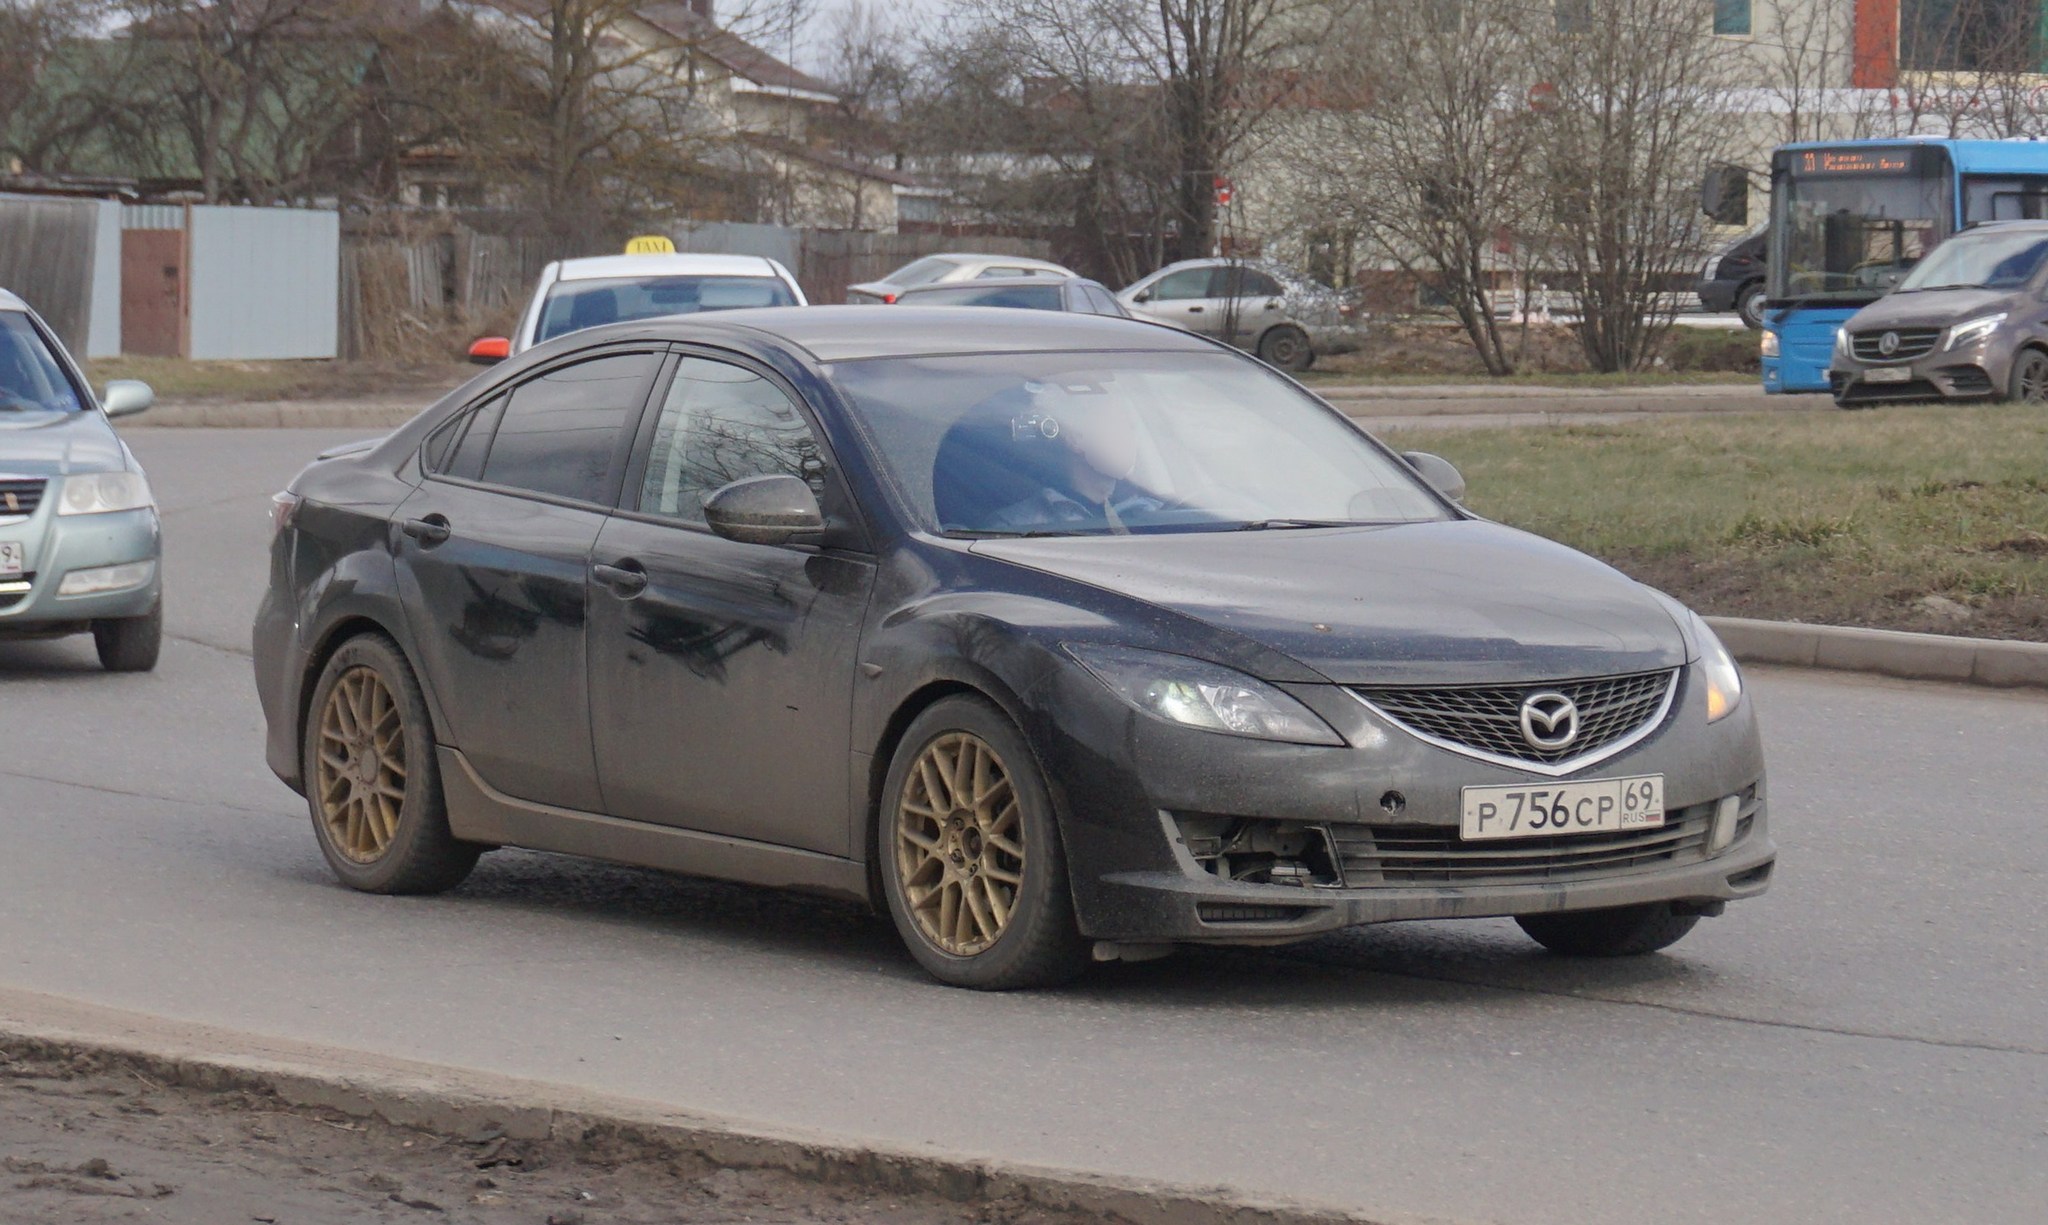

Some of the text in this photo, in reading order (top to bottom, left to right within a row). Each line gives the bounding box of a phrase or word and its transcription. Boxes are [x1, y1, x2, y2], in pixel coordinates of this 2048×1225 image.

[634, 240, 667, 253] TAXI
[1625, 781, 1654, 811] 69
[1623, 811, 1645, 823] RUS
